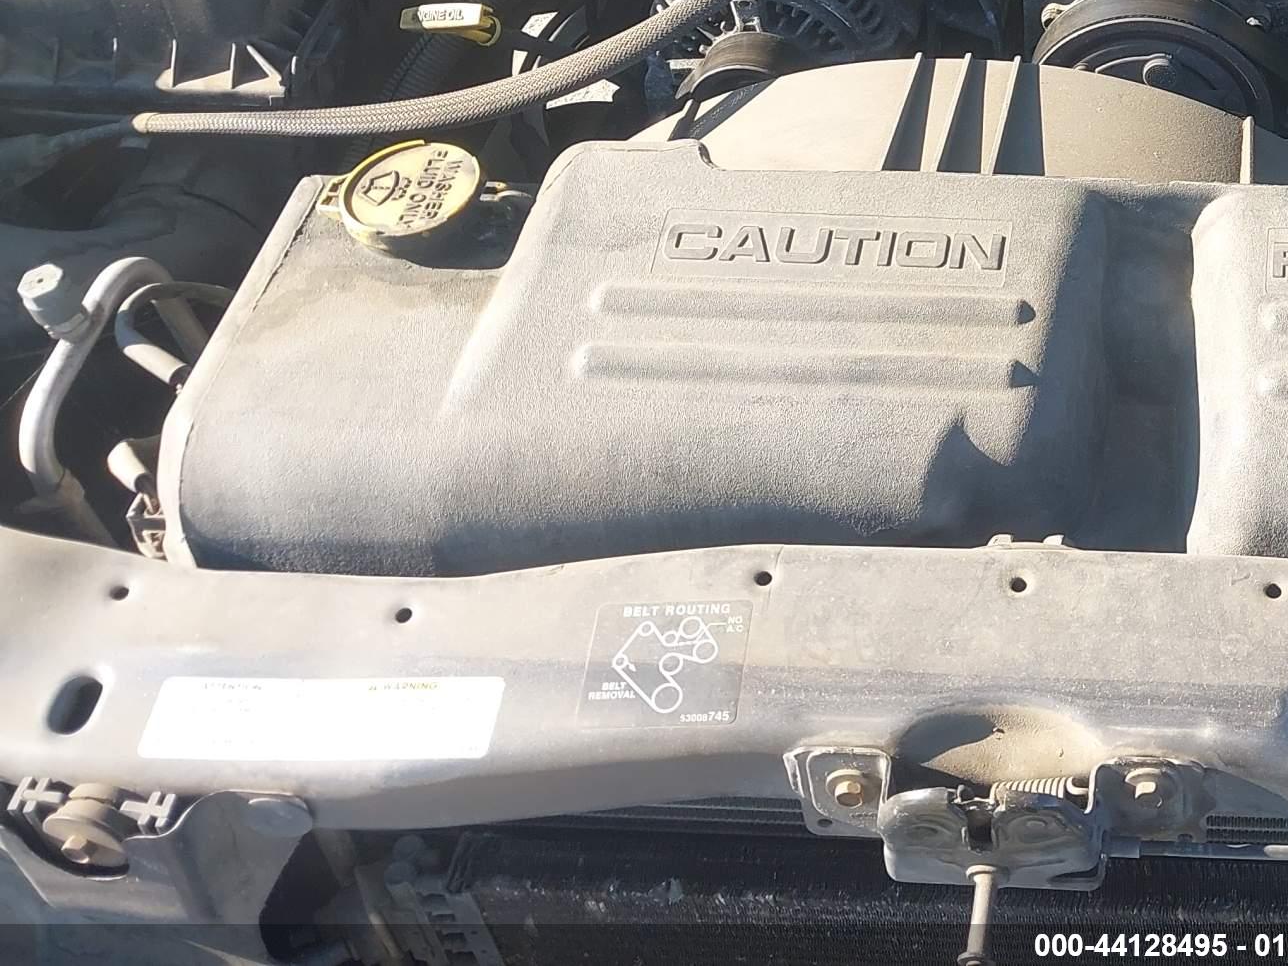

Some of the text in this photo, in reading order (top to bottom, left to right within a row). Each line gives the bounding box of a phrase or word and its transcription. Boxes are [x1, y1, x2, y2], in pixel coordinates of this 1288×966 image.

[448, 9, 464, 21] OIL
[420, 159, 464, 221] WASHER
[662, 223, 1007, 271] CAUTION
[623, 603, 731, 617] BELT ROUTING
[727, 615, 743, 624] NO
[602, 682, 627, 690] BELT
[588, 690, 636, 701] REMOVAL
[679, 710, 730, 723] 53008745
